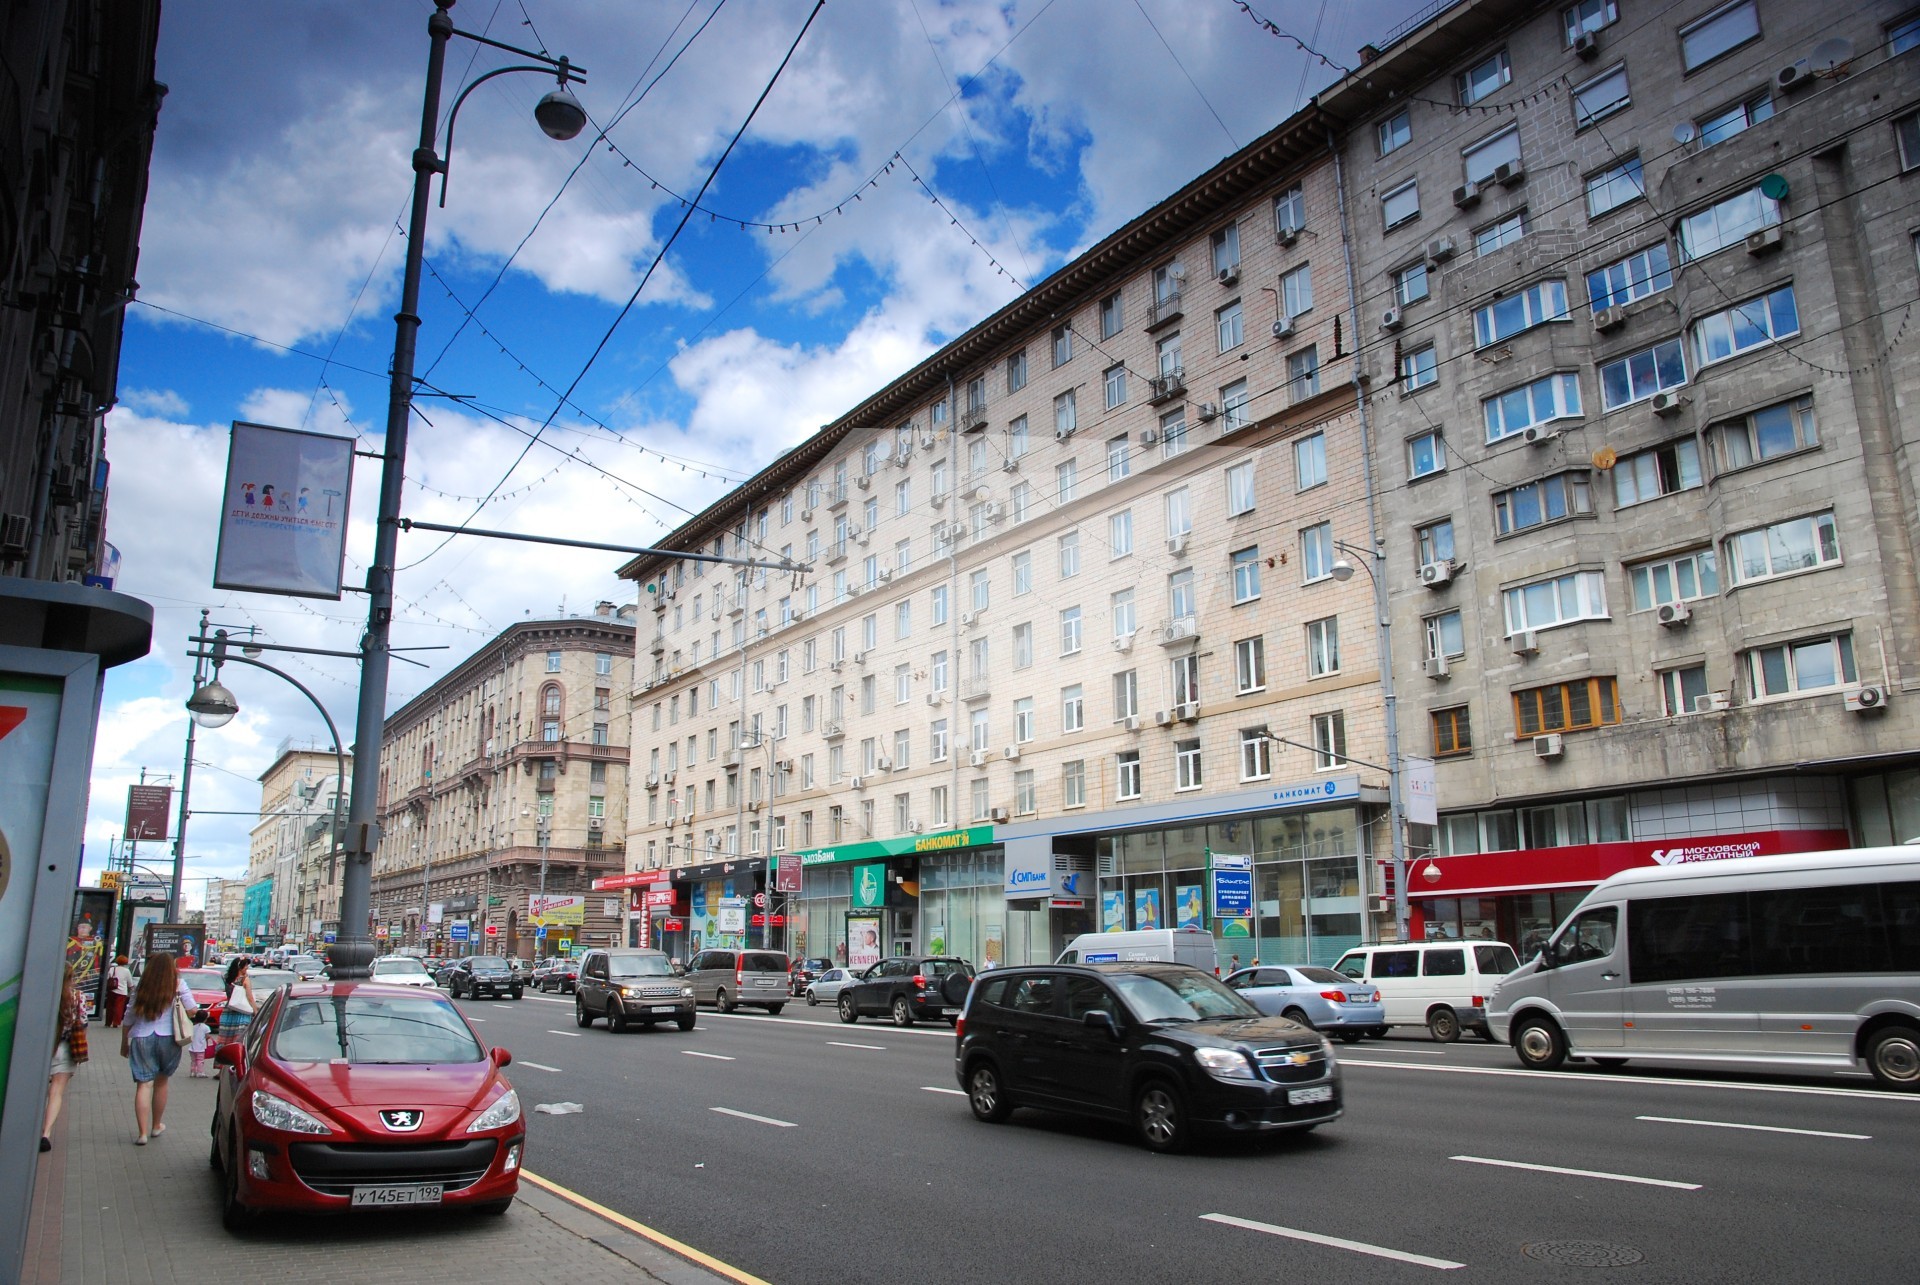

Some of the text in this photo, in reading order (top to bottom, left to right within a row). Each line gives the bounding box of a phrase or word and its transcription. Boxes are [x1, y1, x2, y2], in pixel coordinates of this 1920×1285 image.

[1273, 786, 1321, 800] БАНКОМАТ
[915, 834, 961, 852] БАНКОМАТ
[1685, 842, 1760, 854] МОСКОВСКИЙ
[1686, 850, 1753, 861] КРЕДИТНЫЙ
[849, 955, 879, 965] KENNEDY
[419, 1187, 439, 1197] 199
